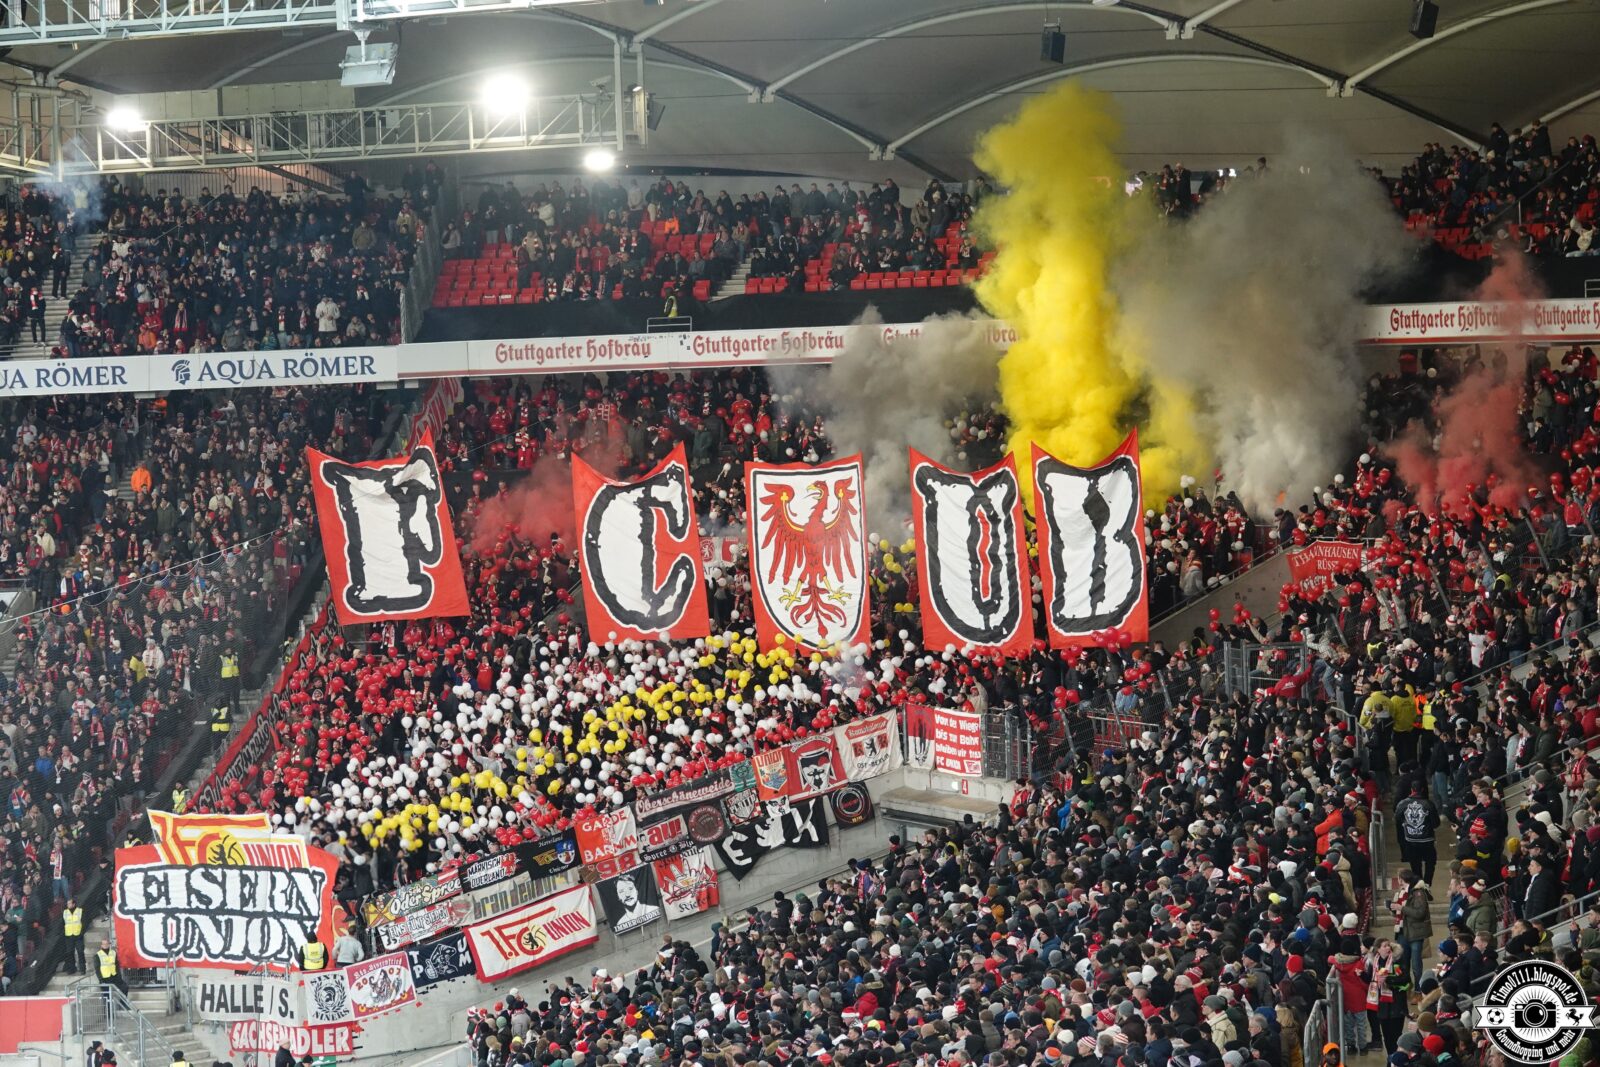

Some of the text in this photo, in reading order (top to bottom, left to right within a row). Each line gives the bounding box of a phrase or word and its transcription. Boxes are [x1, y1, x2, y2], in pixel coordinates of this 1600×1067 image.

[1535, 303, 1590, 331] Stuttgarter
[495, 337, 651, 366] Stuttgarter Hofbräu
[693, 334, 778, 358] Stuttgarter
[35, 362, 128, 388] RÖMER
[198, 352, 377, 385] AQUA RÖMER
[962, 780, 968, 794] 4
[582, 810, 628, 832] GARDE
[243, 843, 302, 868] UNION
[119, 864, 325, 917] EISERN
[390, 878, 461, 915] Oder Spree
[544, 910, 591, 941] UNION
[614, 917, 637, 933] IMMER
[138, 912, 317, 969] UNION
[309, 973, 346, 986] SIXTY
[200, 983, 264, 1013] HALLE
[312, 1006, 350, 1022] NINERS
[231, 1021, 351, 1056] SACHSENADLER
